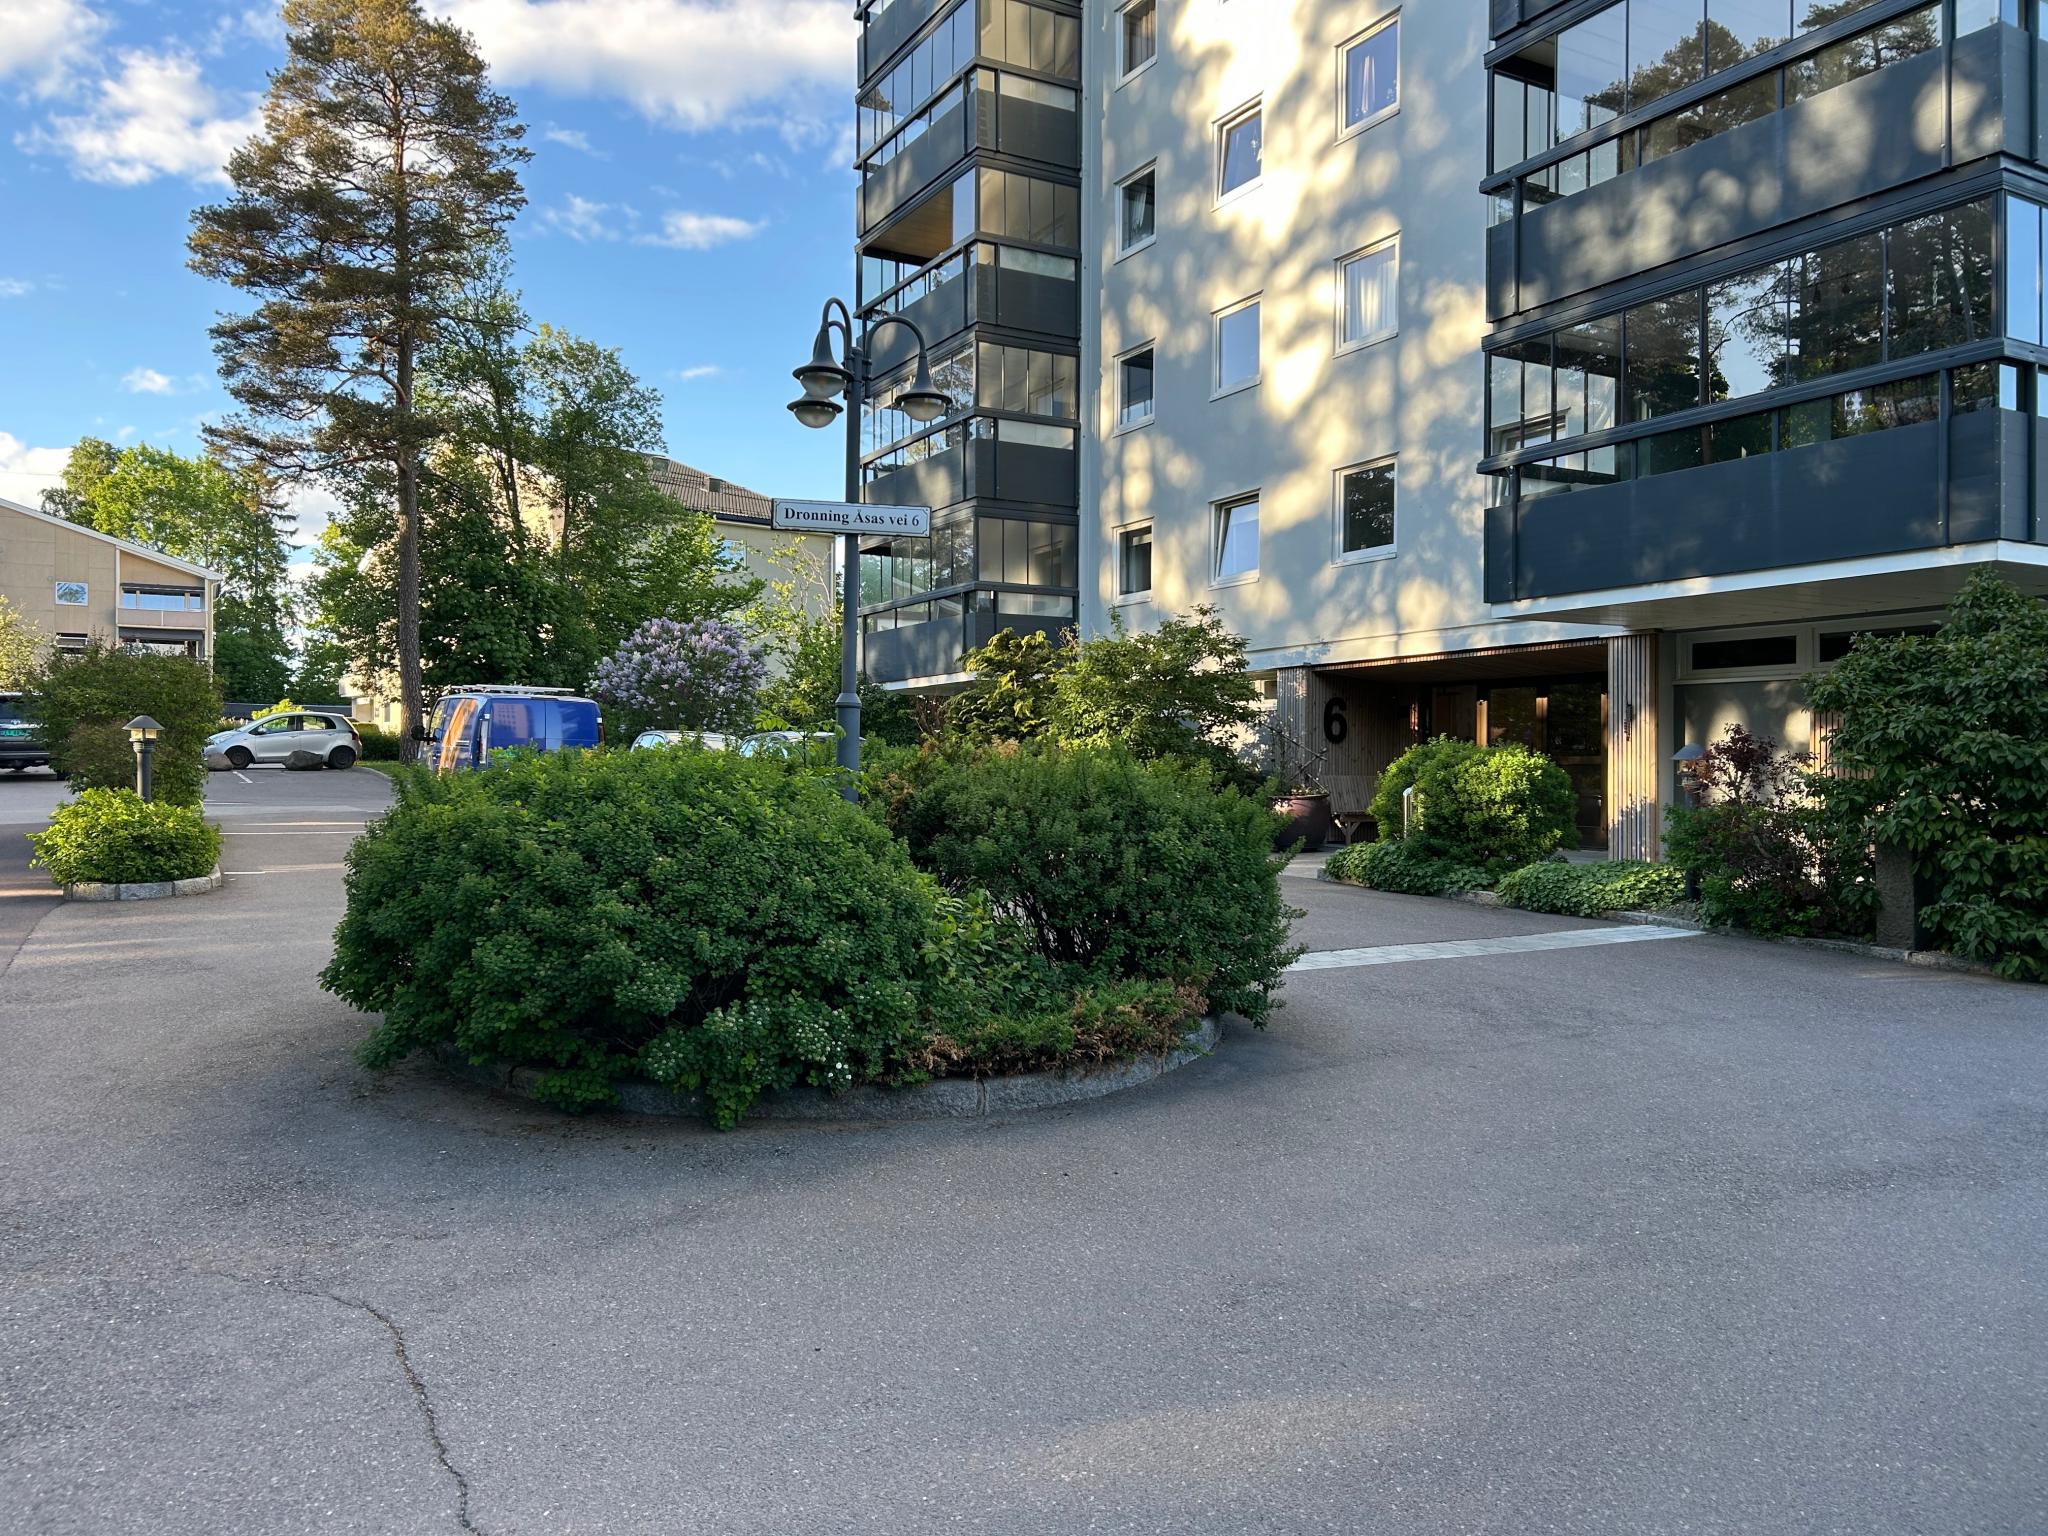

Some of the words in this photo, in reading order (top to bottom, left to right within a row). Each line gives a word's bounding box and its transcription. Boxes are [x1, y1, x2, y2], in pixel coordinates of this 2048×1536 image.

[784, 507, 850, 526] Dronning
[853, 508, 885, 525] Åsas
[888, 513, 908, 526] vei
[911, 514, 920, 527] 6
[1323, 697, 1348, 744] 6
